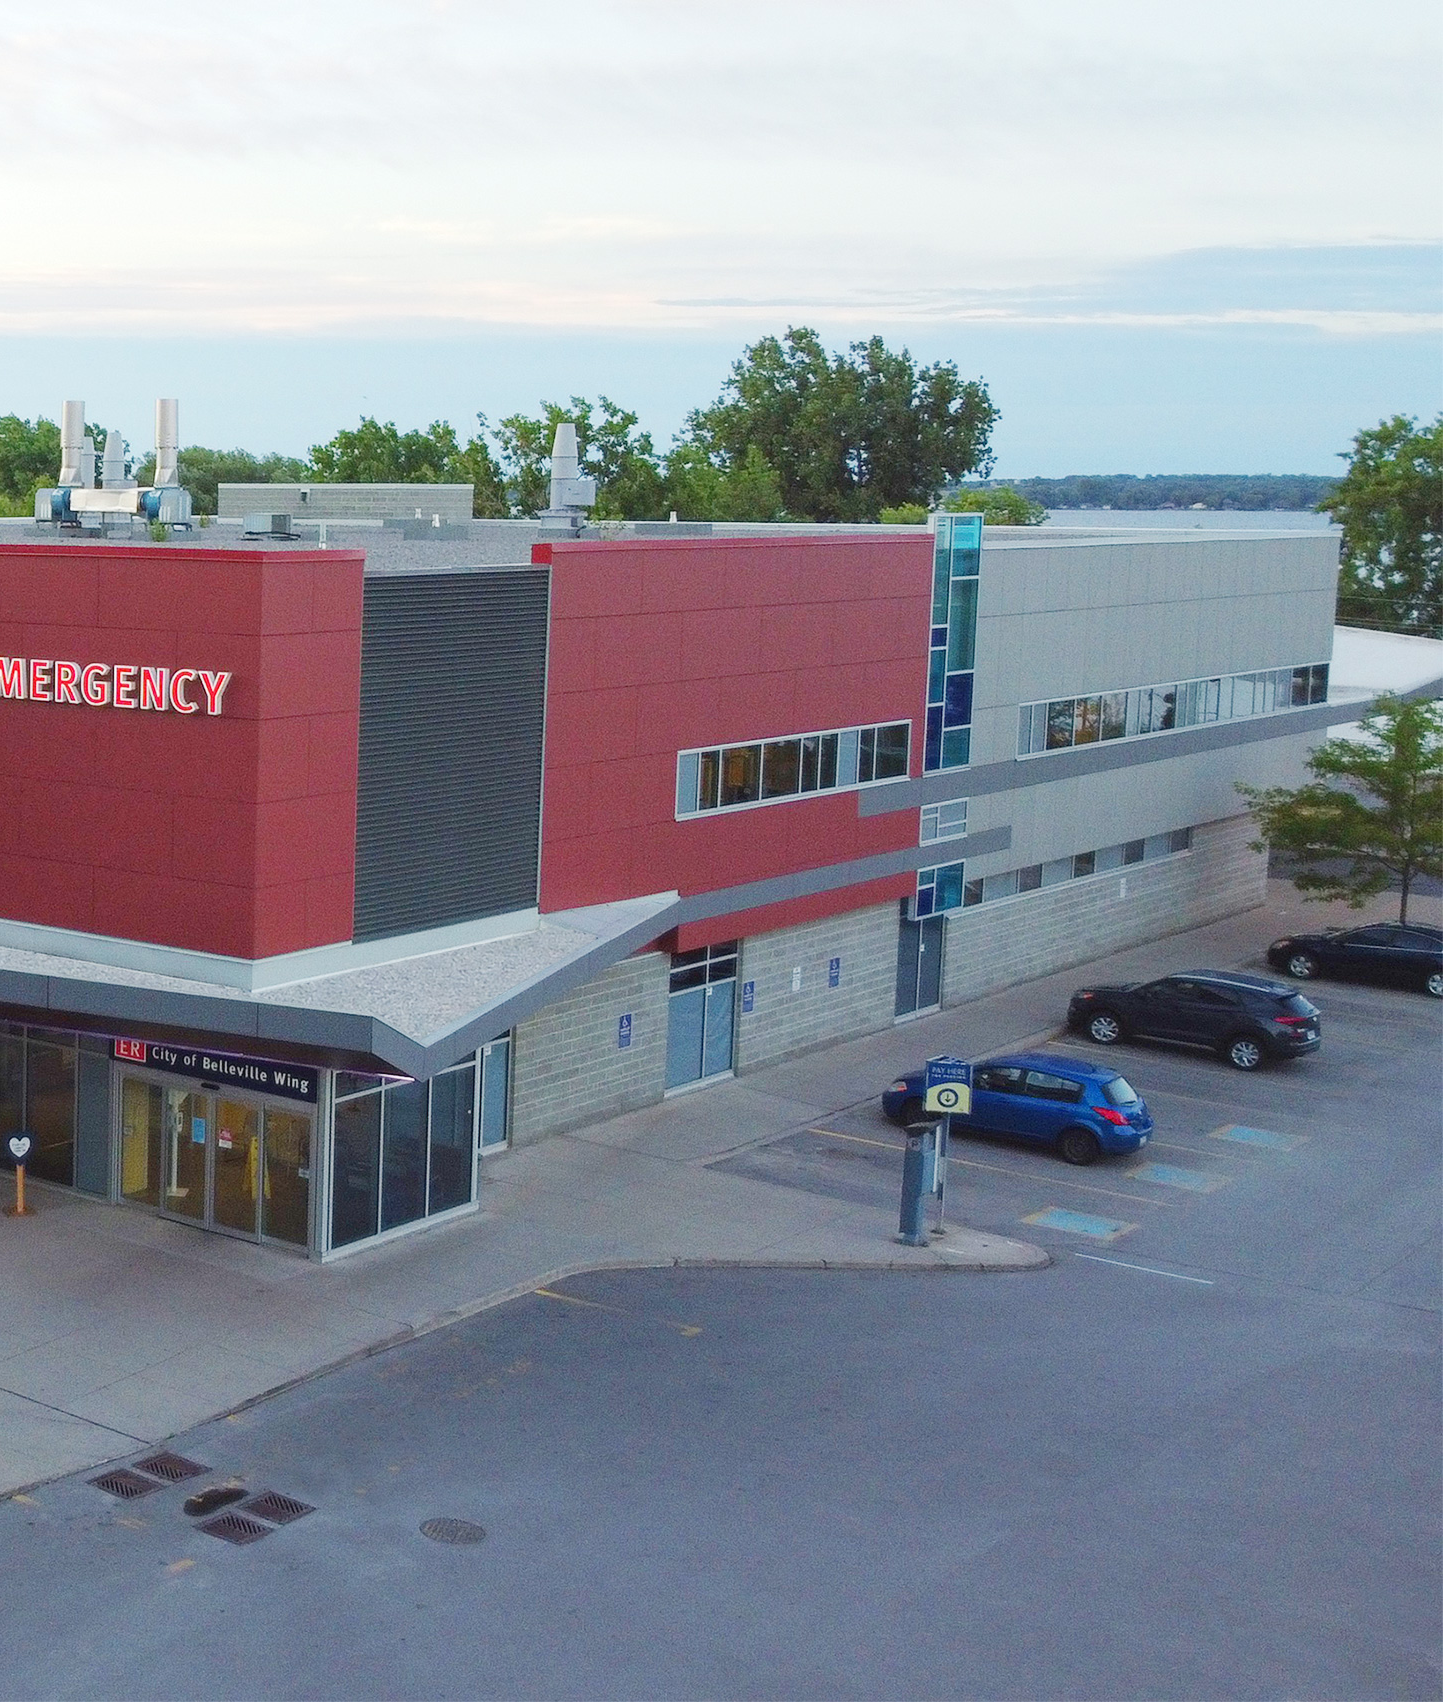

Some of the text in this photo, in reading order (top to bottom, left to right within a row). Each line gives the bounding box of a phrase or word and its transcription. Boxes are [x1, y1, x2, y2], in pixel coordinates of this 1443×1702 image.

[119, 1040, 140, 1058] ER
[152, 1047, 310, 1094] City of Belleville Wing
